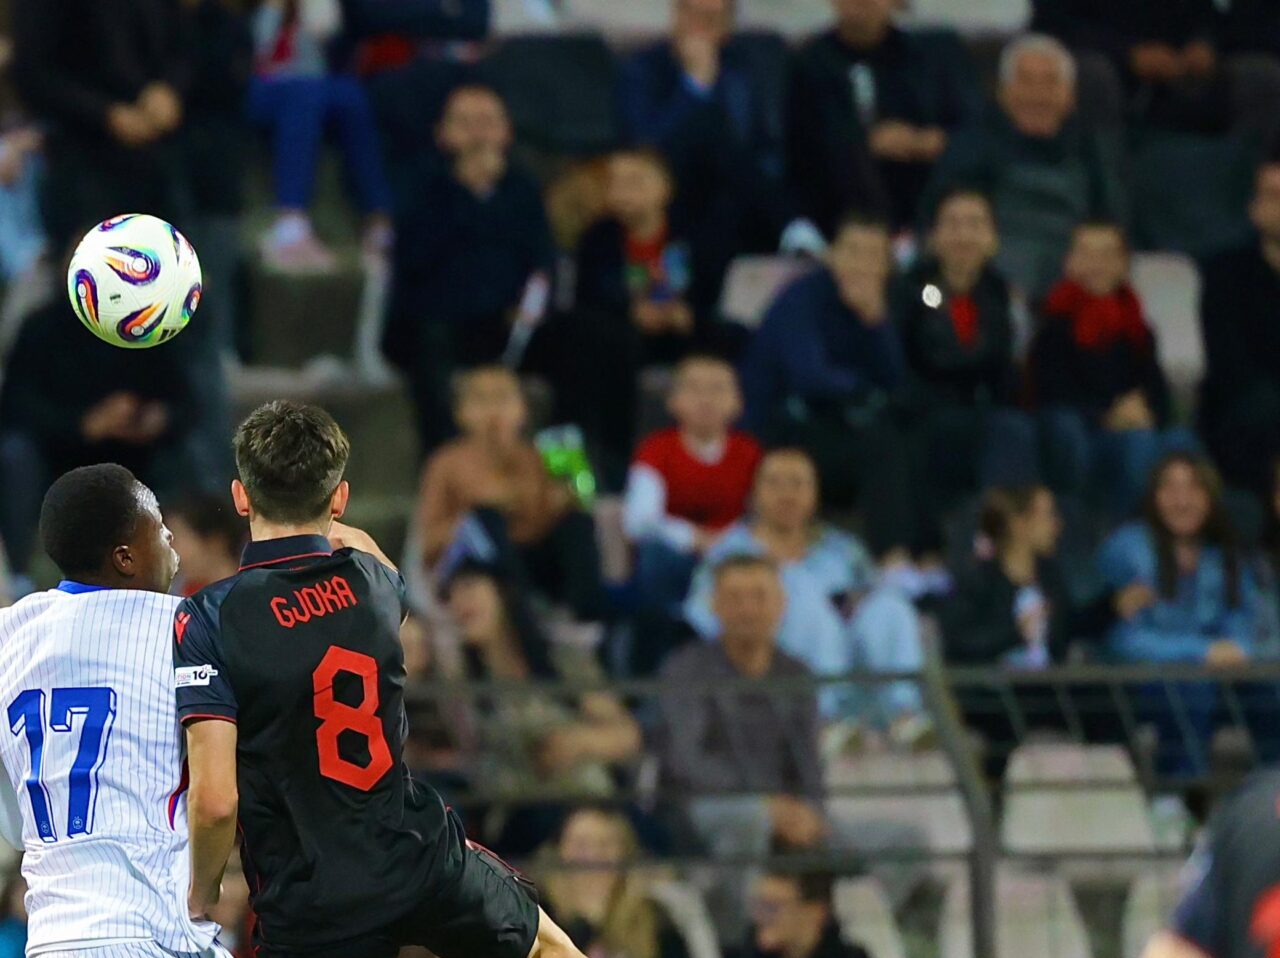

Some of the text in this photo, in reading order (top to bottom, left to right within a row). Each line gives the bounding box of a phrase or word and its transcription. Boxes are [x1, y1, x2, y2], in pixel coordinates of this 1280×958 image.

[270, 575, 358, 628] GJOKA
[7, 687, 118, 843] 17
[312, 644, 395, 792] 8
